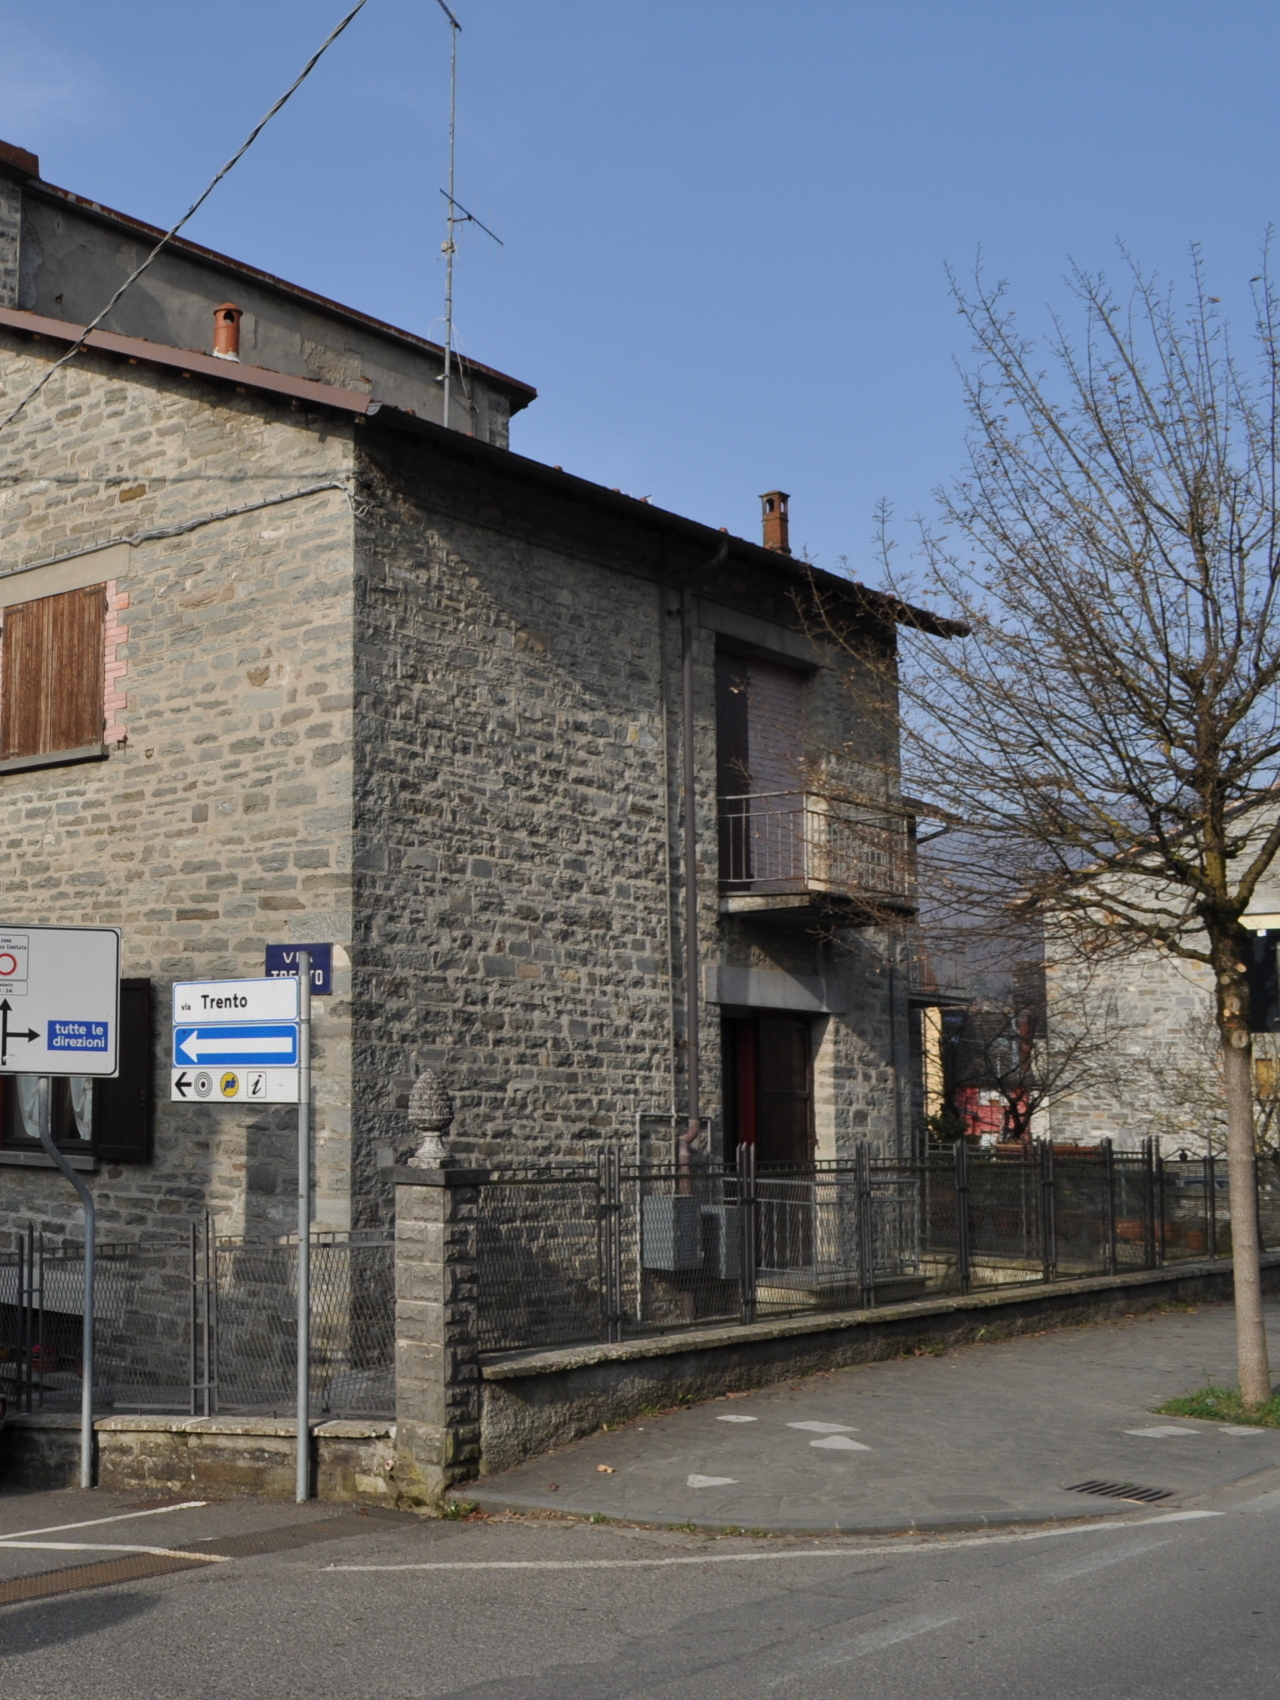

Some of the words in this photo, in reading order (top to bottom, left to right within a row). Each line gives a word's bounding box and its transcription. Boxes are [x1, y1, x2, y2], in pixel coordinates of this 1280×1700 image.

[282, 951, 313, 964] VI
[181, 1003, 191, 1011] via
[201, 994, 248, 1010] Trento
[55, 1023, 87, 1035] tutte
[91, 1024, 104, 1036] le
[52, 1035, 105, 1048] direzioni
